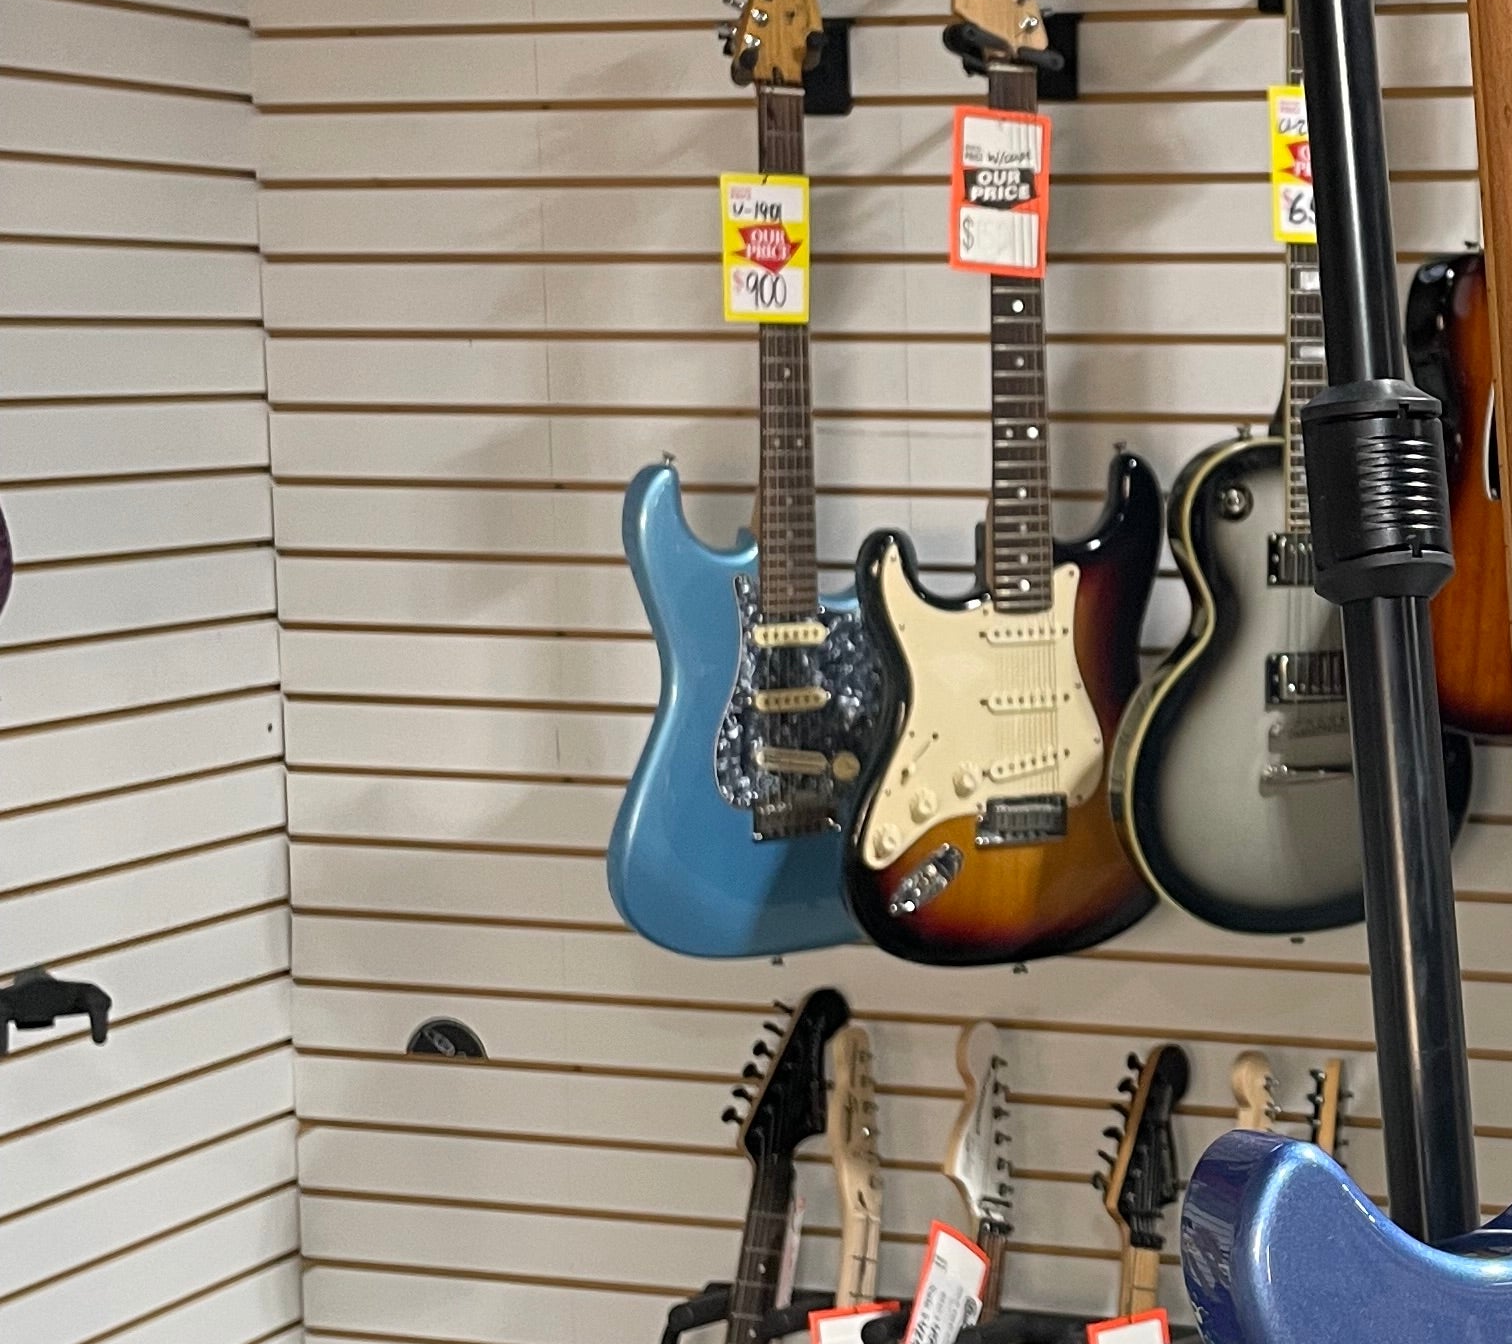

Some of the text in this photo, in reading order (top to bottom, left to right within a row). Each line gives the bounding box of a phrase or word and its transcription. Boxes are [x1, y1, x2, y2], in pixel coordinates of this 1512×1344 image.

[976, 169, 1022, 186] OUR
[969, 183, 1032, 202] PRICE
[750, 228, 786, 244] OUR
[961, 215, 976, 253] $
